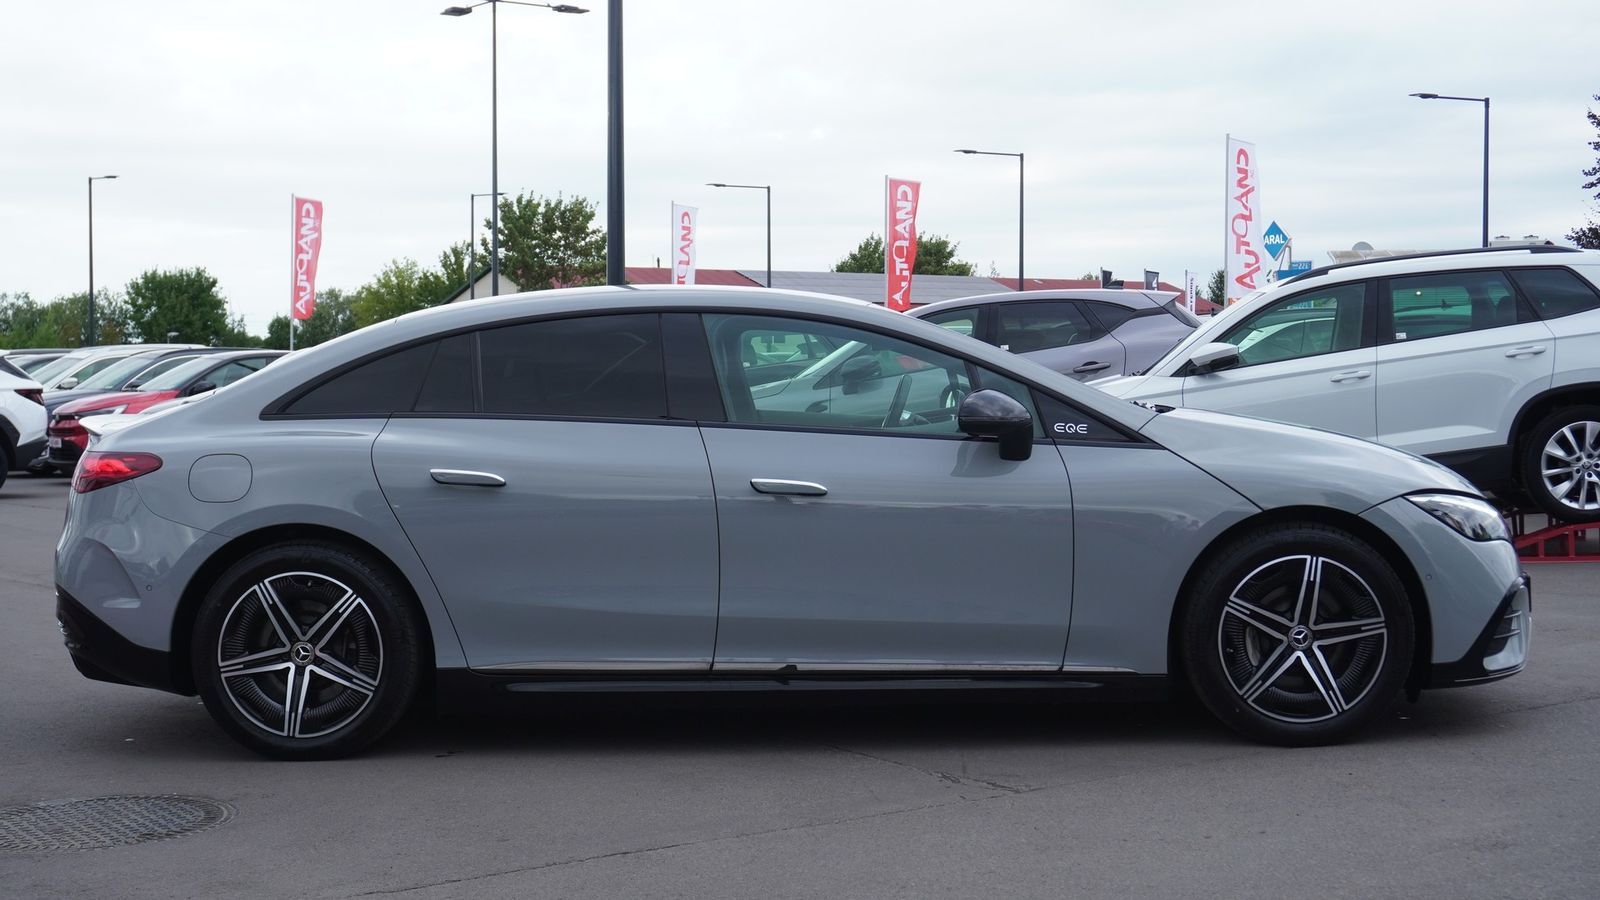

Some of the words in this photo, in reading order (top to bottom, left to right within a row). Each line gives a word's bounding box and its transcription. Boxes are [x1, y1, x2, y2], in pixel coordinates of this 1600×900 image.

[295, 201, 319, 315] AUTOLAND
[892, 184, 914, 306] AUTOLAND
[1231, 147, 1261, 290] AUTOLAND
[1264, 233, 1285, 245] ARAL
[1054, 422, 1088, 434] EQE
